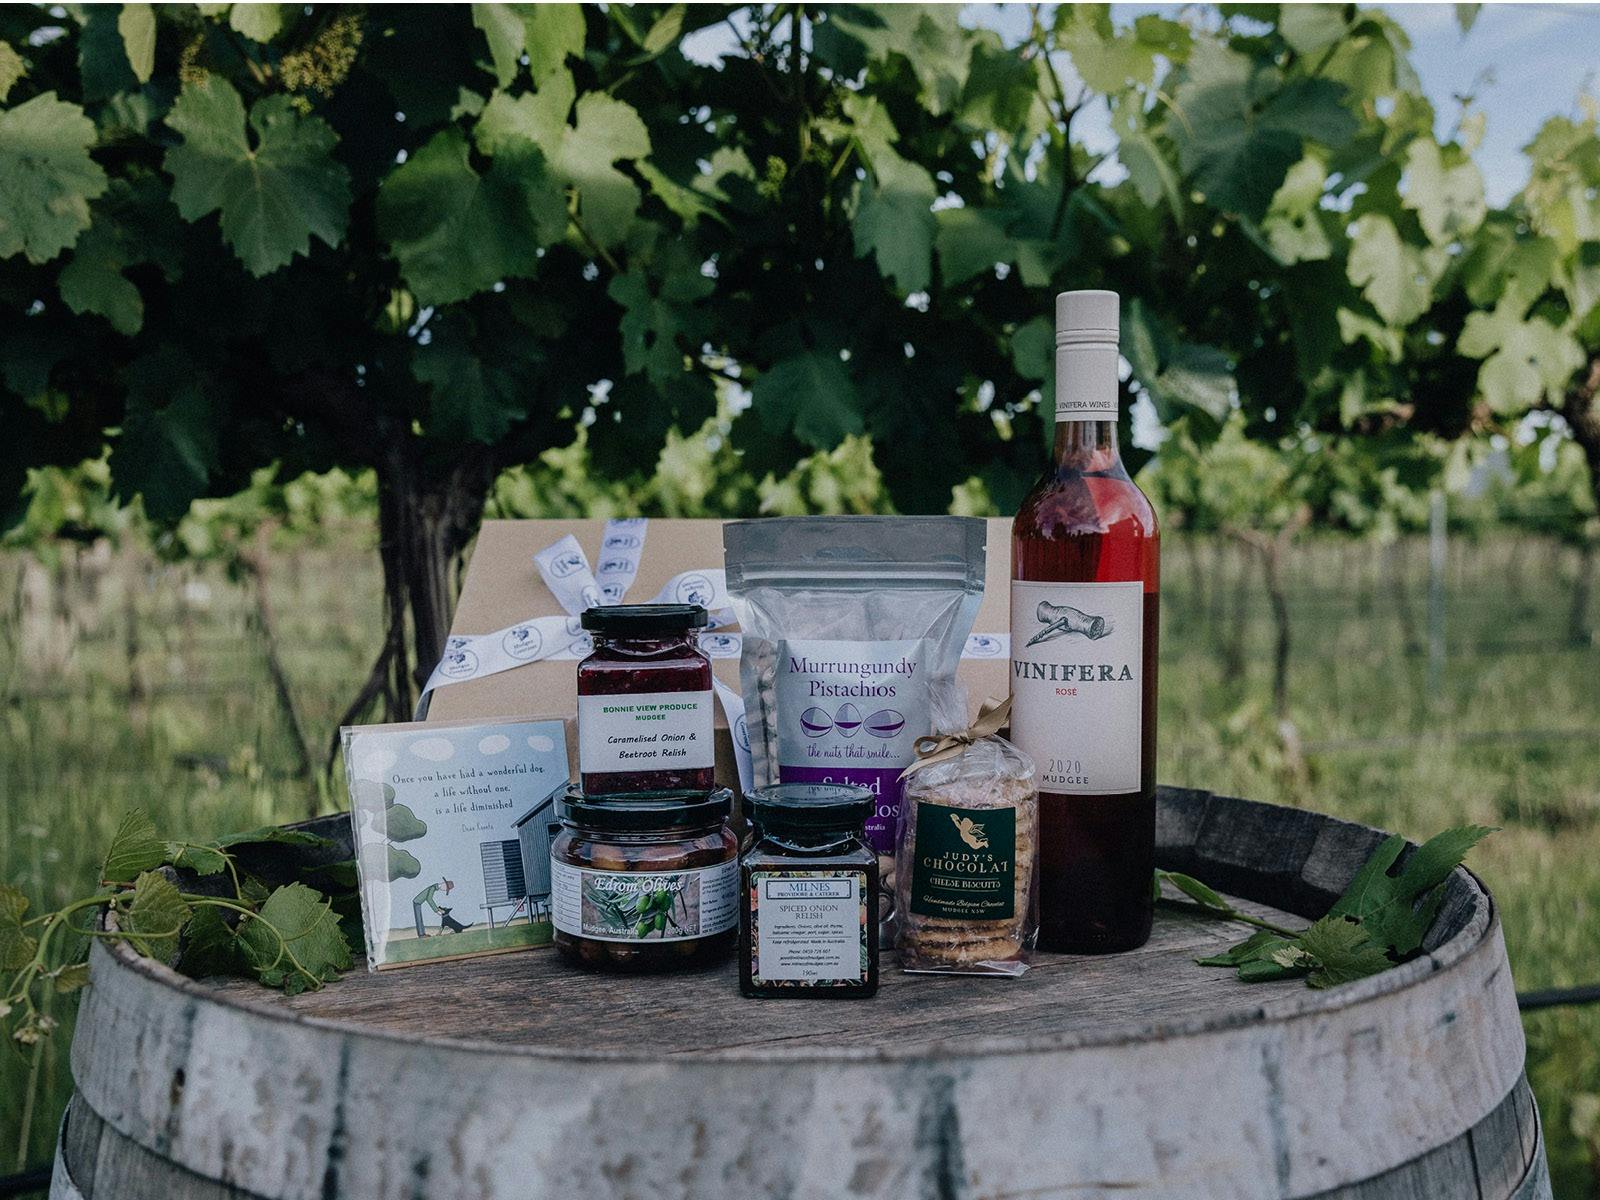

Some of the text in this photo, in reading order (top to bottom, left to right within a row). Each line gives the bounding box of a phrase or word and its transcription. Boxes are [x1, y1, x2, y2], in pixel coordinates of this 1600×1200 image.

[1089, 401, 1111, 409] WINES
[789, 656, 918, 679] Murrungundy
[1013, 660, 1134, 682] VINIFERA
[809, 680, 897, 698] Pistachios
[1055, 687, 1078, 696] ROSÉ
[603, 703, 698, 714] BONNIE VIEW PRODUCE
[607, 732, 697, 745] Caramelised Onion &
[618, 748, 687, 759] Beetroot Relish
[806, 743, 823, 757] the
[823, 746, 842, 758] nuts
[844, 744, 865, 758] that
[1049, 759, 1082, 774] 2020
[392, 774, 415, 784] Once
[418, 776, 433, 784] you
[436, 771, 456, 781] have
[459, 768, 476, 779] had
[487, 764, 527, 776] wonderful
[1042, 775, 1089, 785] MUDGEE
[442, 786, 456, 797] life
[459, 784, 492, 796] without
[453, 803, 467, 813] life
[470, 799, 513, 812] diminished
[943, 852, 993, 861] JUDY'S
[923, 857, 1008, 873] CHOCOLAT
[594, 876, 639, 893] Edrom
[641, 877, 684, 893] Olives
[789, 882, 831, 892] MILNES
[929, 877, 1001, 888] CHEESE BISCUITS
[779, 904, 839, 913] SPICED ONION
[795, 912, 823, 920] RELISH
[608, 926, 639, 935] Australia
